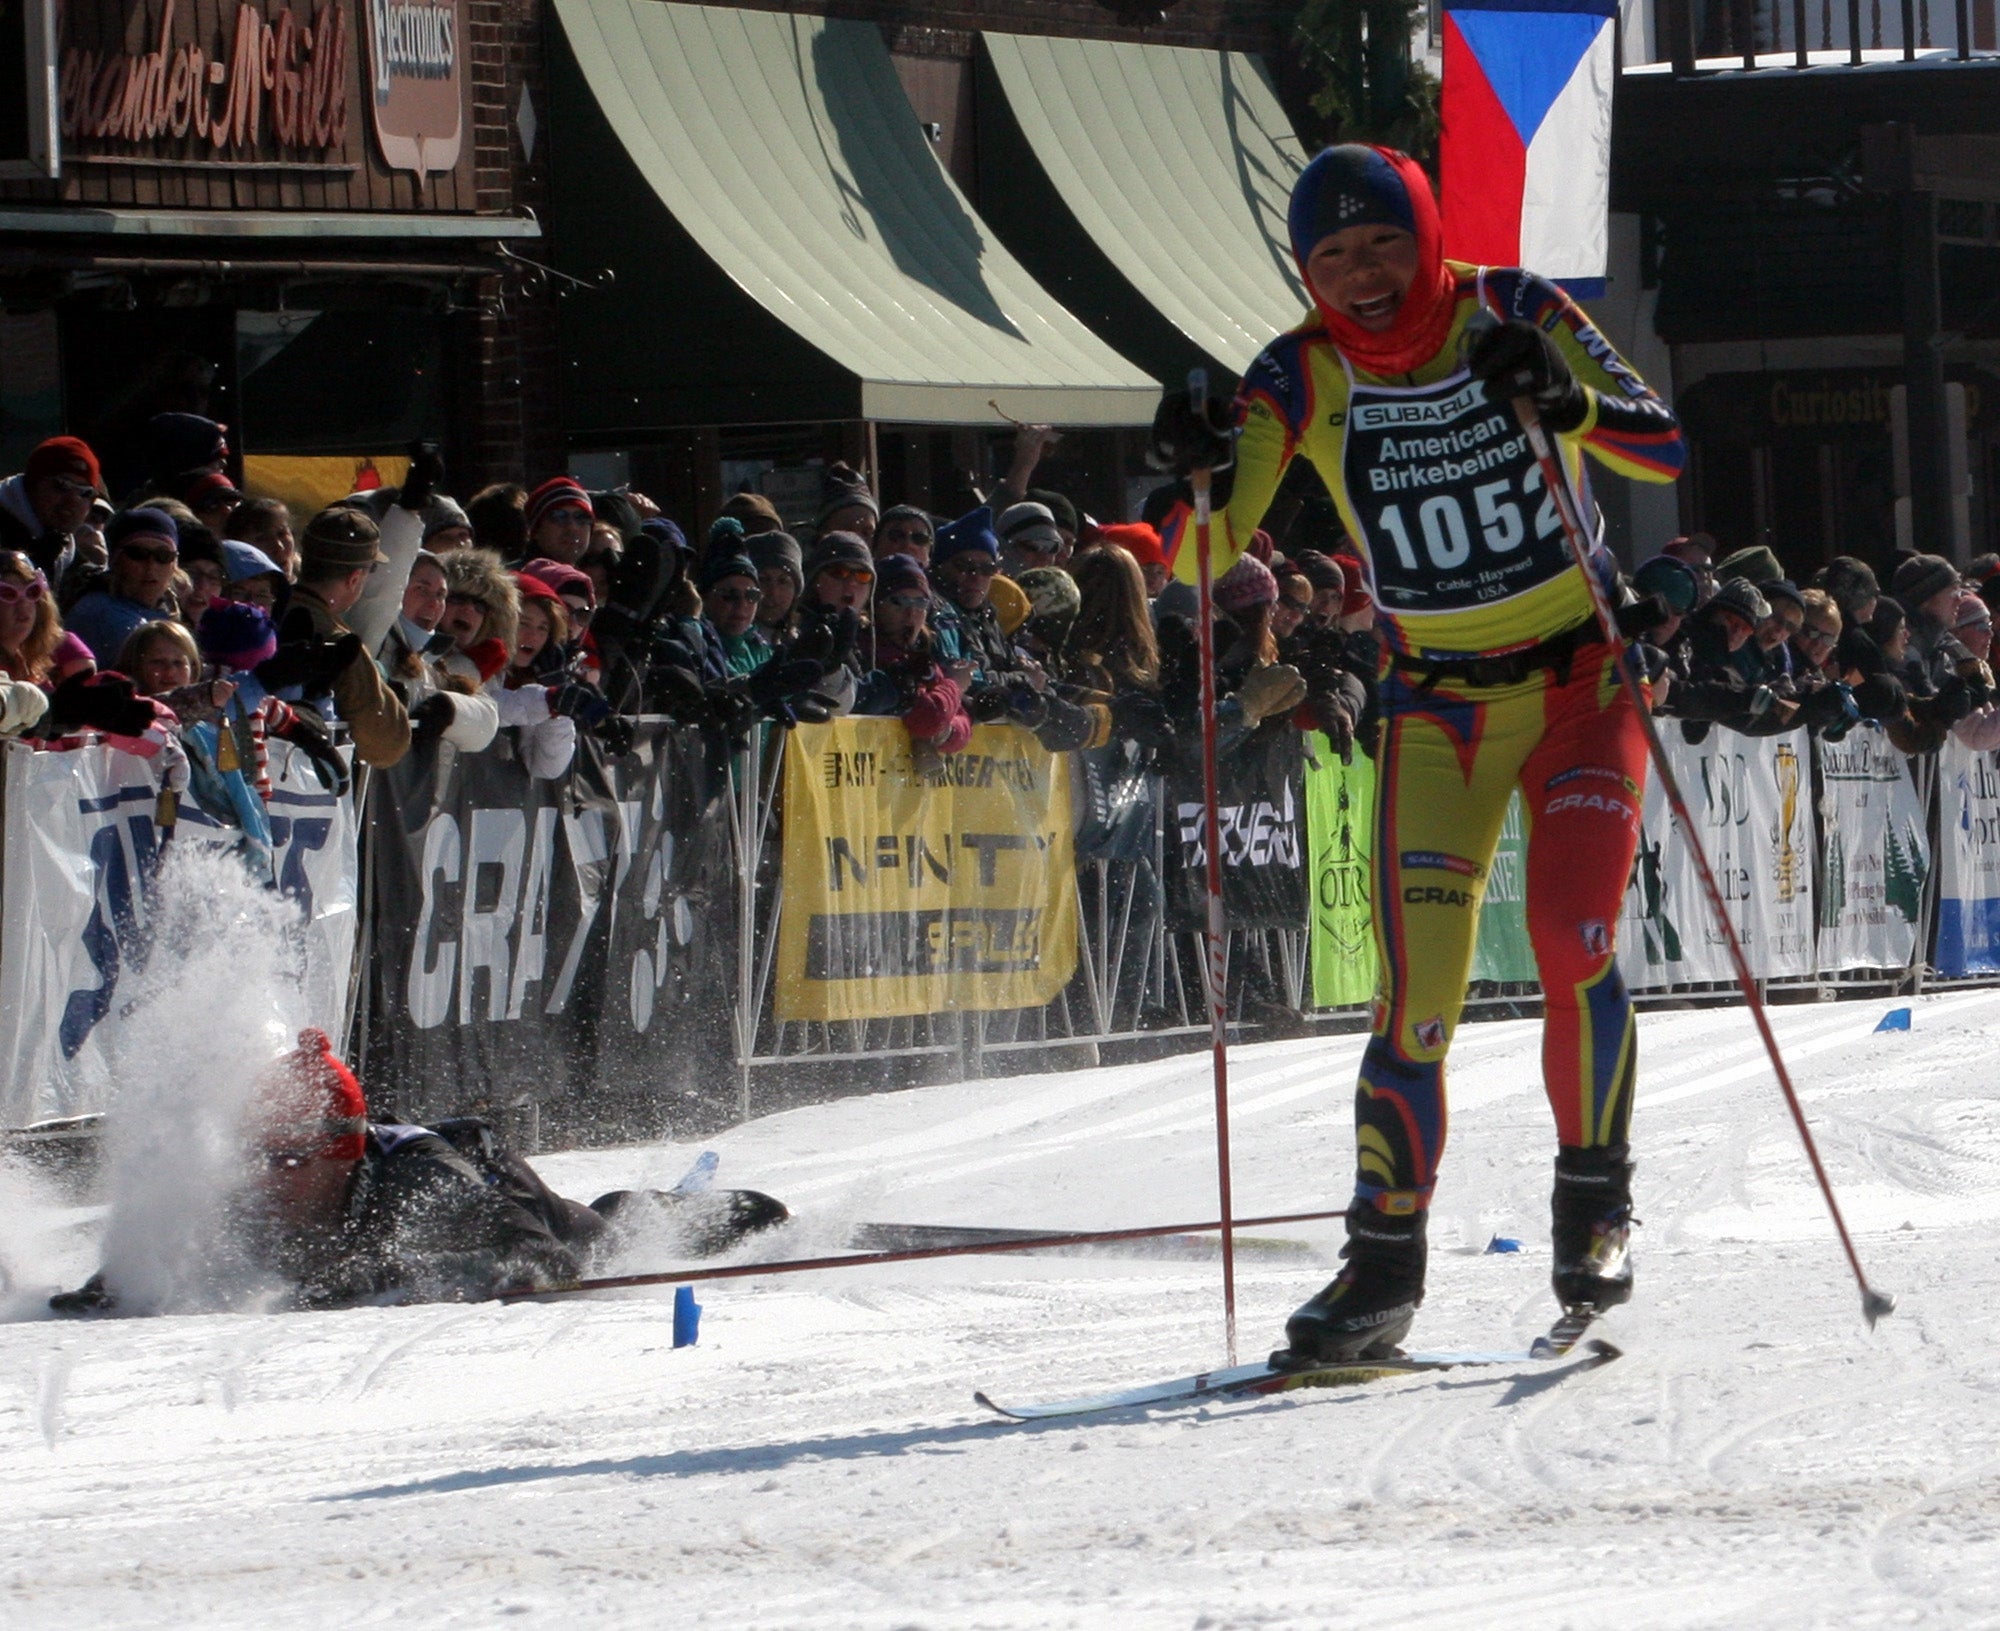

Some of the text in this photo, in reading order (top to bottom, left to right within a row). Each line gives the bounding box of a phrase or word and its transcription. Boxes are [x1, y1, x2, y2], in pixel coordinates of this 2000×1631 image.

[1363, 390, 1474, 427] SUBARU
[1772, 380, 1893, 432] Curiosit
[1379, 415, 1508, 463] American
[1368, 433, 1527, 492] Birkebeiner
[1378, 462, 1564, 570] 1052
[1476, 583, 1509, 600] USA
[1545, 793, 1633, 820] CRAFT
[1404, 886, 1475, 907] CRAF
